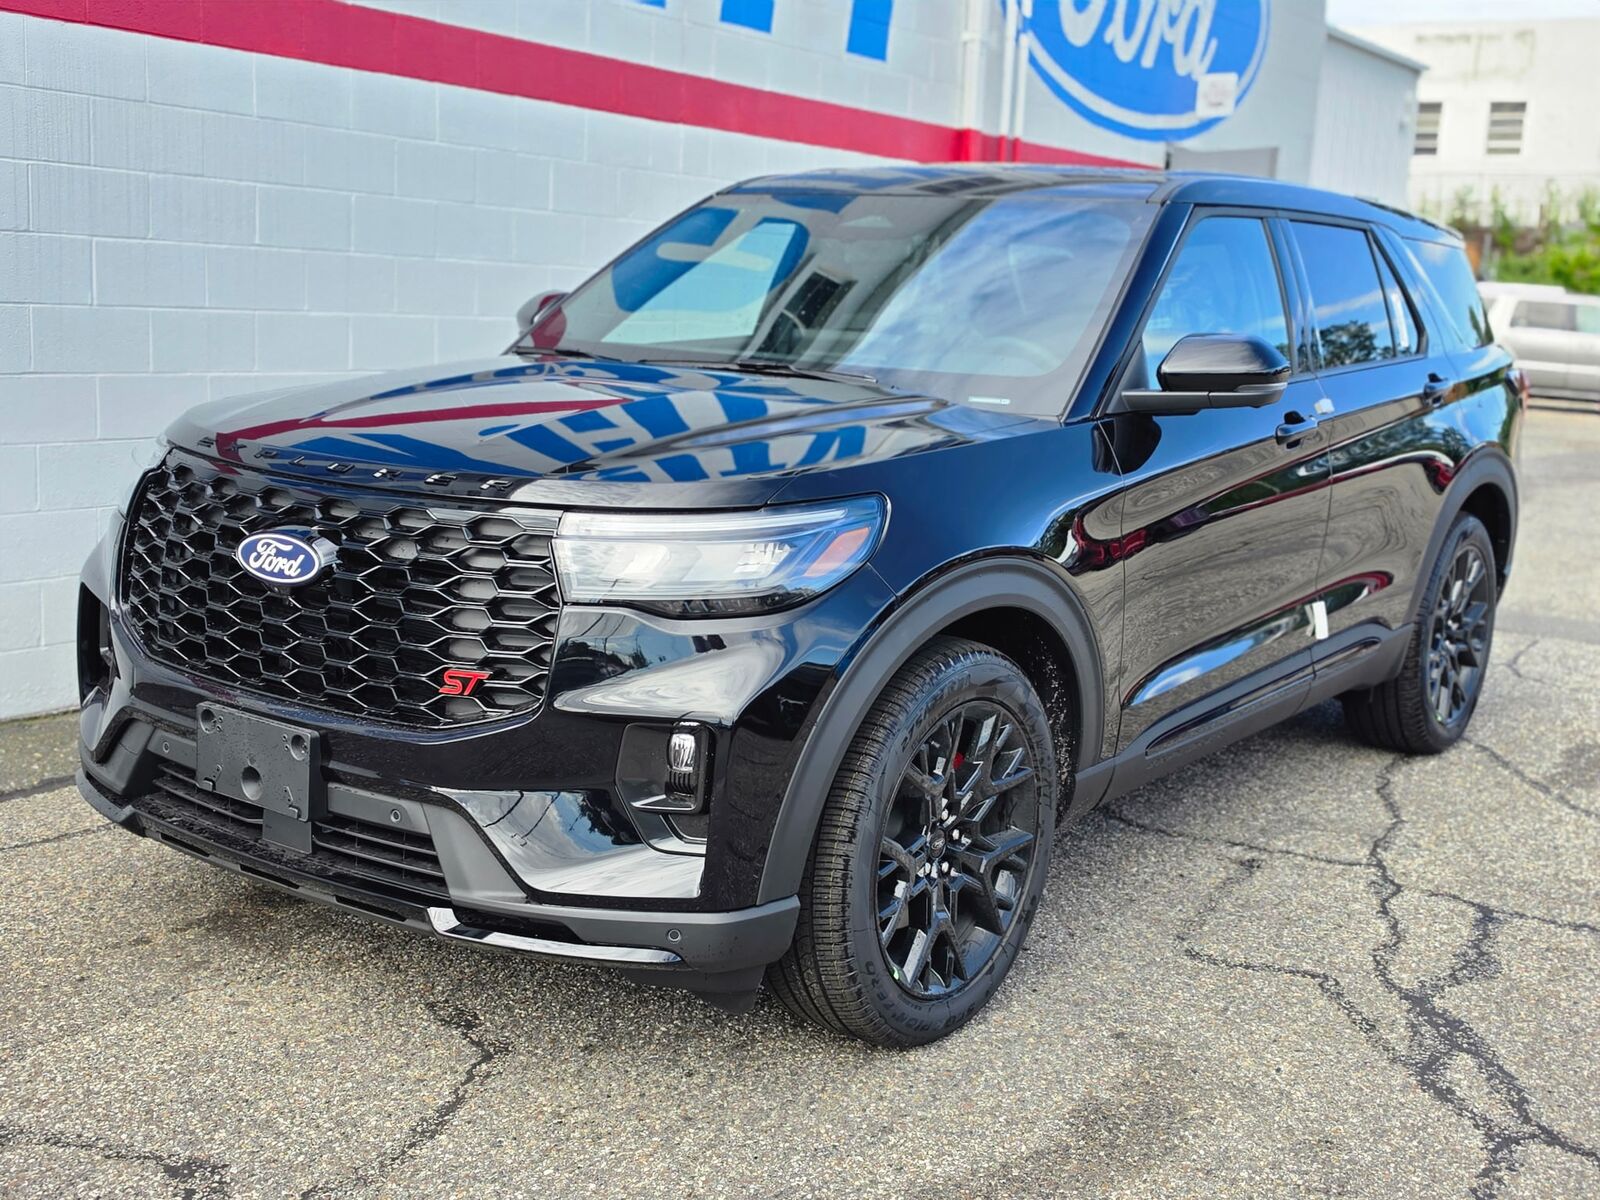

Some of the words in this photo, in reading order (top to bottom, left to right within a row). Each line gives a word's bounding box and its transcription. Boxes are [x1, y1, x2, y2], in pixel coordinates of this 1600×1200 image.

[197, 436, 513, 491] EXPLORER
[249, 538, 305, 577] Ford
[439, 669, 493, 695] ST
